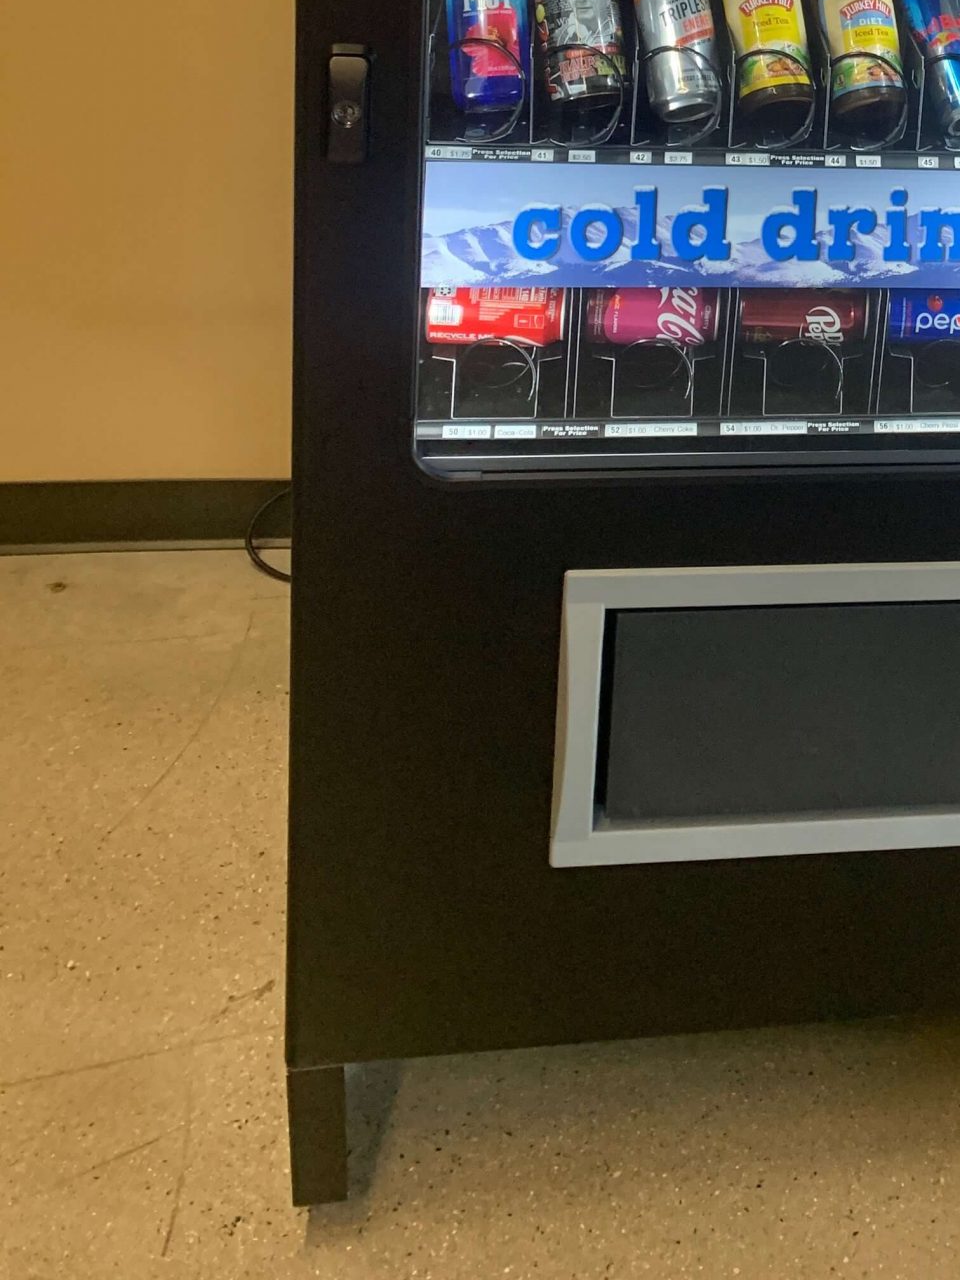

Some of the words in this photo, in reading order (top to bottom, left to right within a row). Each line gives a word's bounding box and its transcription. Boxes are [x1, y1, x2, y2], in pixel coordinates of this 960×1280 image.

[842, 0, 874, 20] TURKEY
[876, 0, 892, 16] HILL
[752, 18, 772, 28] Iced
[774, 16, 790, 25] Tea
[858, 16, 883, 26] DIET
[854, 28, 874, 38] Iced
[876, 28, 889, 36] Tea
[430, 148, 442, 156] 40
[635, 153, 646, 162] 42
[730, 155, 741, 163] 43
[830, 158, 840, 166] 44
[923, 158, 934, 166] 45
[512, 184, 731, 262] cold
[429, 332, 476, 340] RECYCLE
[610, 426, 620, 434] 52
[654, 425, 675, 434] Cherry
[678, 424, 694, 432] Coke
[726, 424, 736, 432] 54
[879, 422, 888, 430] 56
